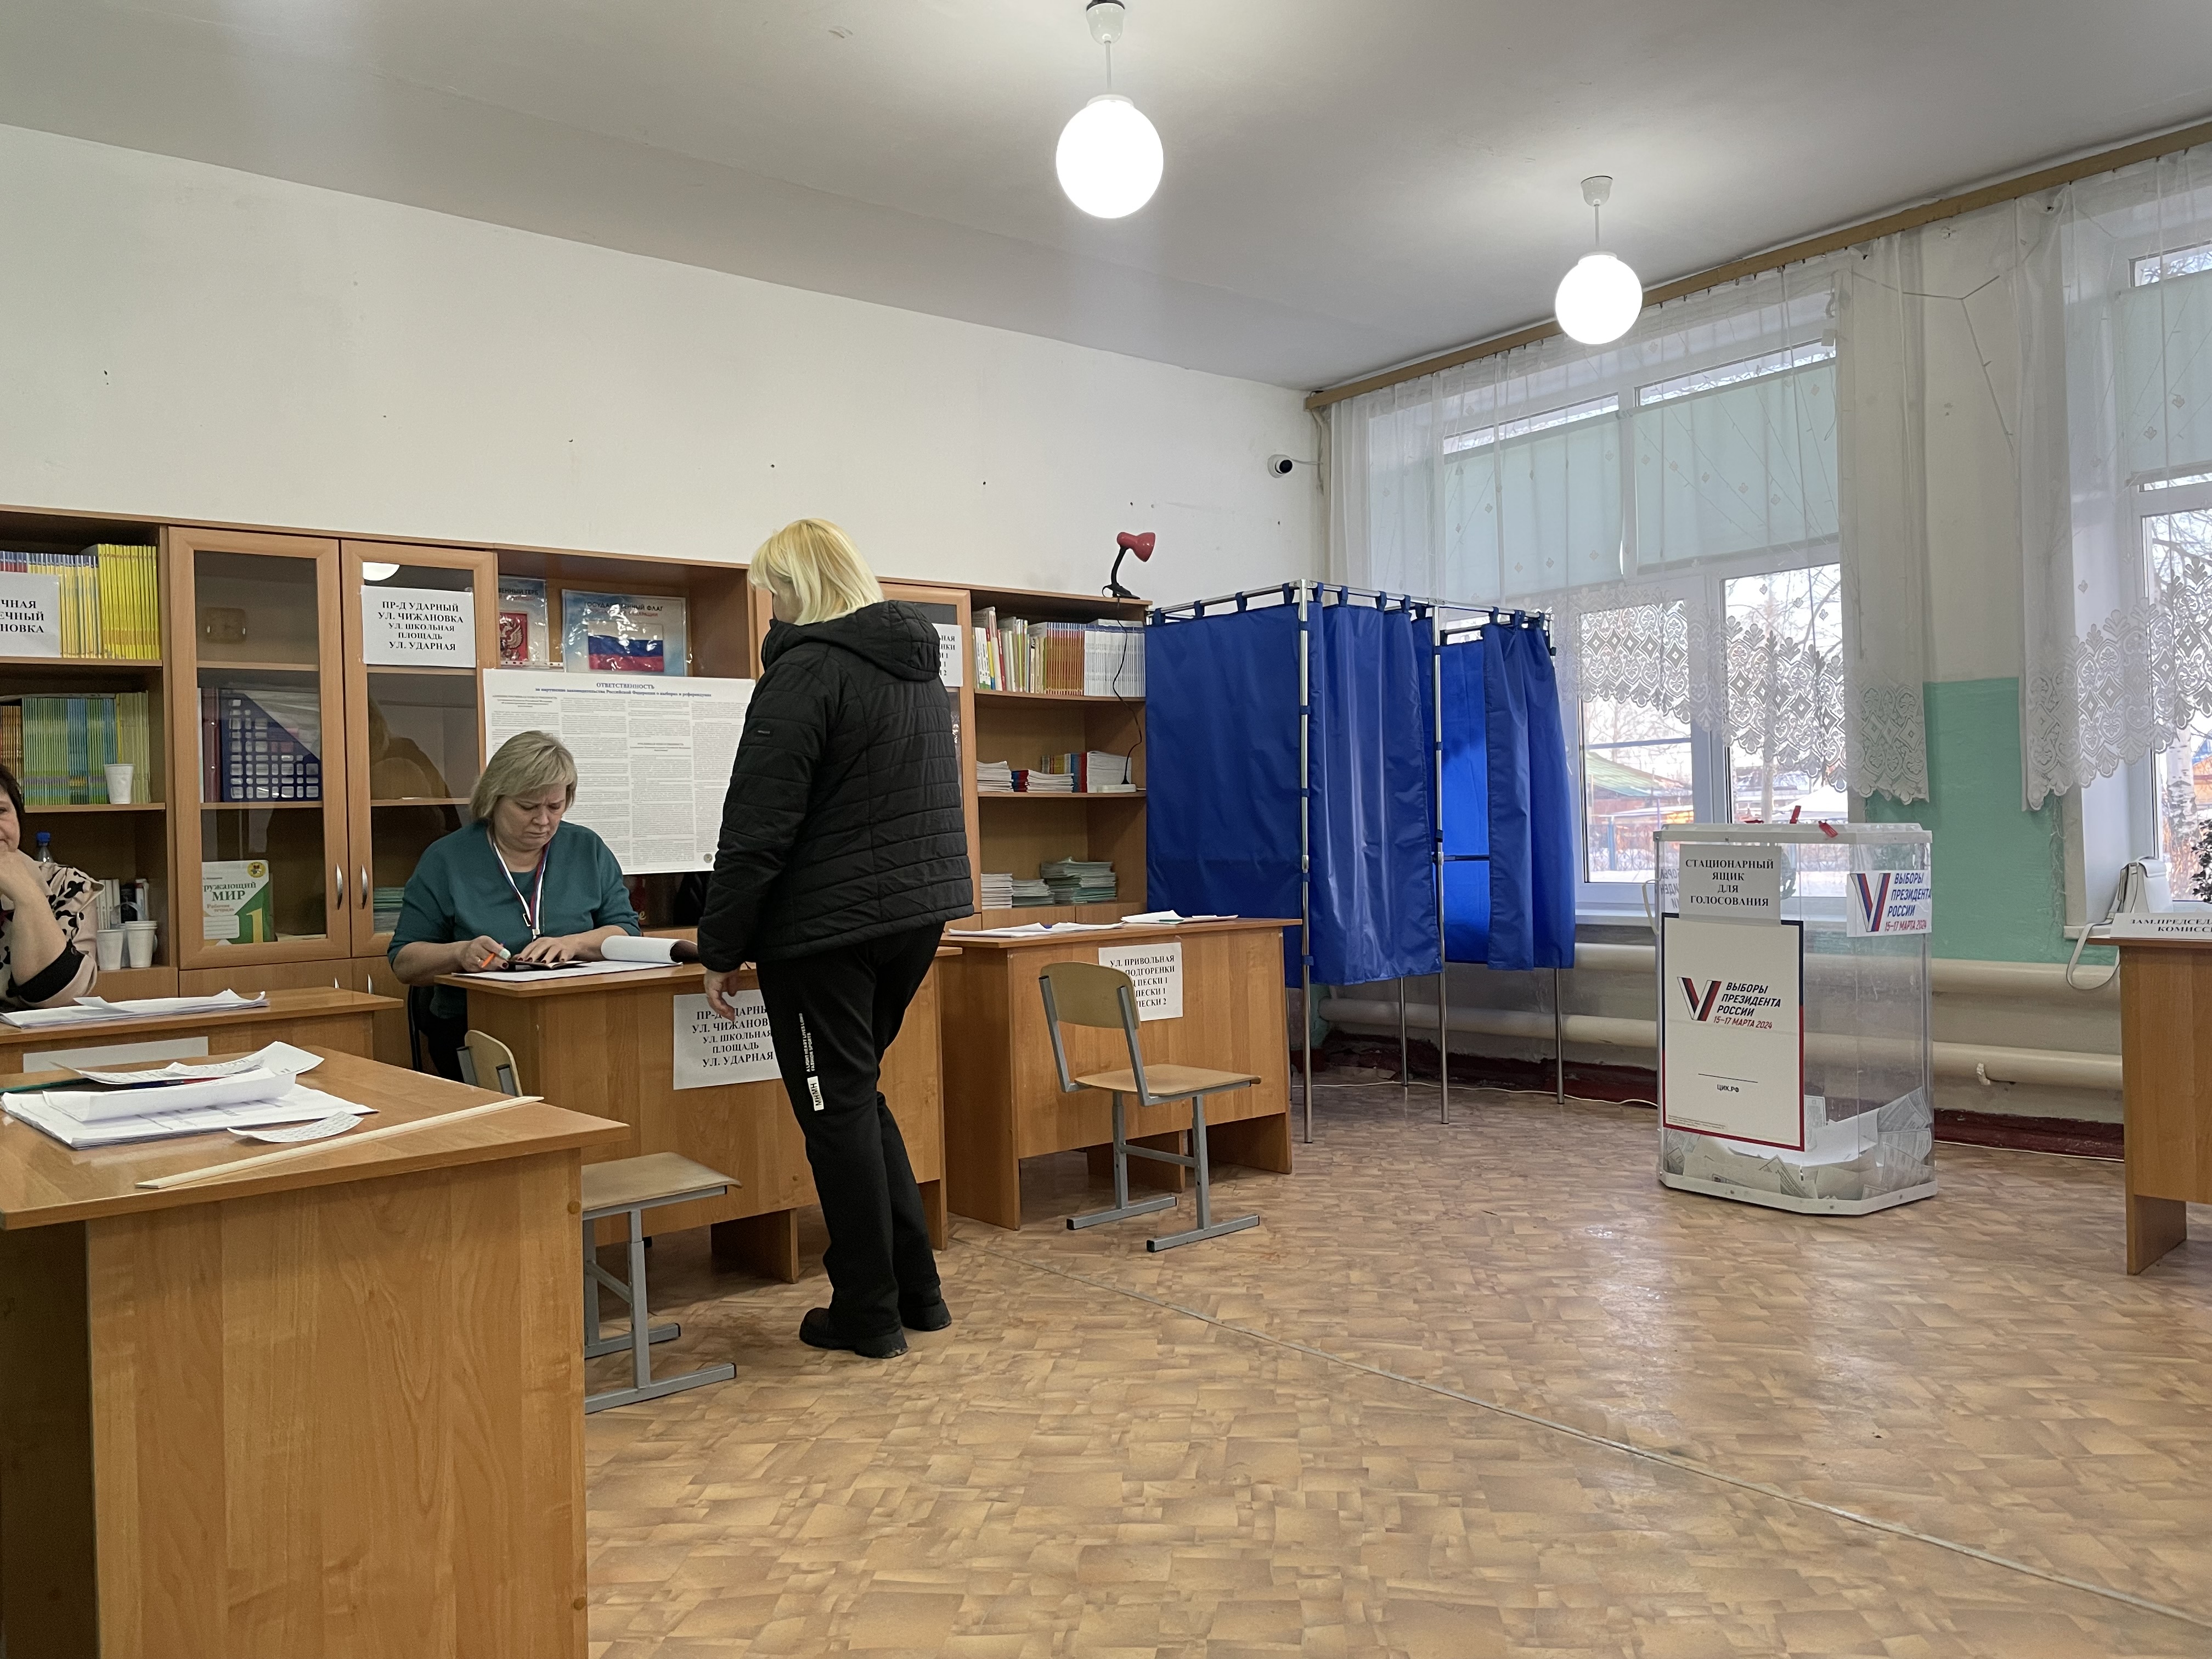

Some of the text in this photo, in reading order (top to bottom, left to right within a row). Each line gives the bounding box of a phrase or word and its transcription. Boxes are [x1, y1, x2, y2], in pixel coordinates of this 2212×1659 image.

[1, 600, 37, 608] ЧНАЯ
[382, 601, 458, 612] ПР-Д УДАРНЫЙ
[0, 611, 44, 620] ЕЧНЫЙ
[378, 612, 463, 623] УЛ. ЧИЖАНОВКА
[0, 624, 44, 633] НОВКА
[398, 632, 442, 640] ПЛОЩАДЬ
[409, 642, 455, 650] УДАРНАЯ
[1685, 859, 1774, 869] СТАЦИОНАРНЫЙ
[1712, 872, 1745, 882] ЯЩИК
[1894, 872, 1924, 884] ВЫБОРЫ
[204, 882, 256, 892] ружающий
[1717, 884, 1739, 893] ДЛЯ
[212, 890, 245, 901] МИР
[1891, 888, 1931, 902] ПРЕЗИДЕНТА
[1690, 896, 1769, 906] ГОЛОСОВАНИЯ
[1887, 905, 1916, 917] РОССИИ
[1899, 921, 1915, 930] МАРТА
[1915, 919, 1927, 930] 2024
[1125, 955, 1175, 966] ПРИВОЛЬНАЯ
[1138, 978, 1163, 986] ПЕСКИ
[1136, 989, 1161, 997] ПЕСКИ
[1726, 982, 1768, 994] ВЫБОРЫ
[1137, 998, 1161, 1007] ПЕСКИ
[1722, 994, 1781, 1007] ПРЕЗИДЕНТА
[1717, 1005, 1754, 1017] РОССИИ
[692, 1018, 769, 1034] УЛ. ЧИЖАНОВ
[1732, 1018, 1754, 1027] МАРТА
[1756, 1021, 1773, 1029] 2024
[703, 1036, 718, 1044] УЛ.
[713, 1042, 759, 1053] ПЛОЩАДЬ
[702, 1052, 774, 1068] УЛ. УДАРНАЯ
